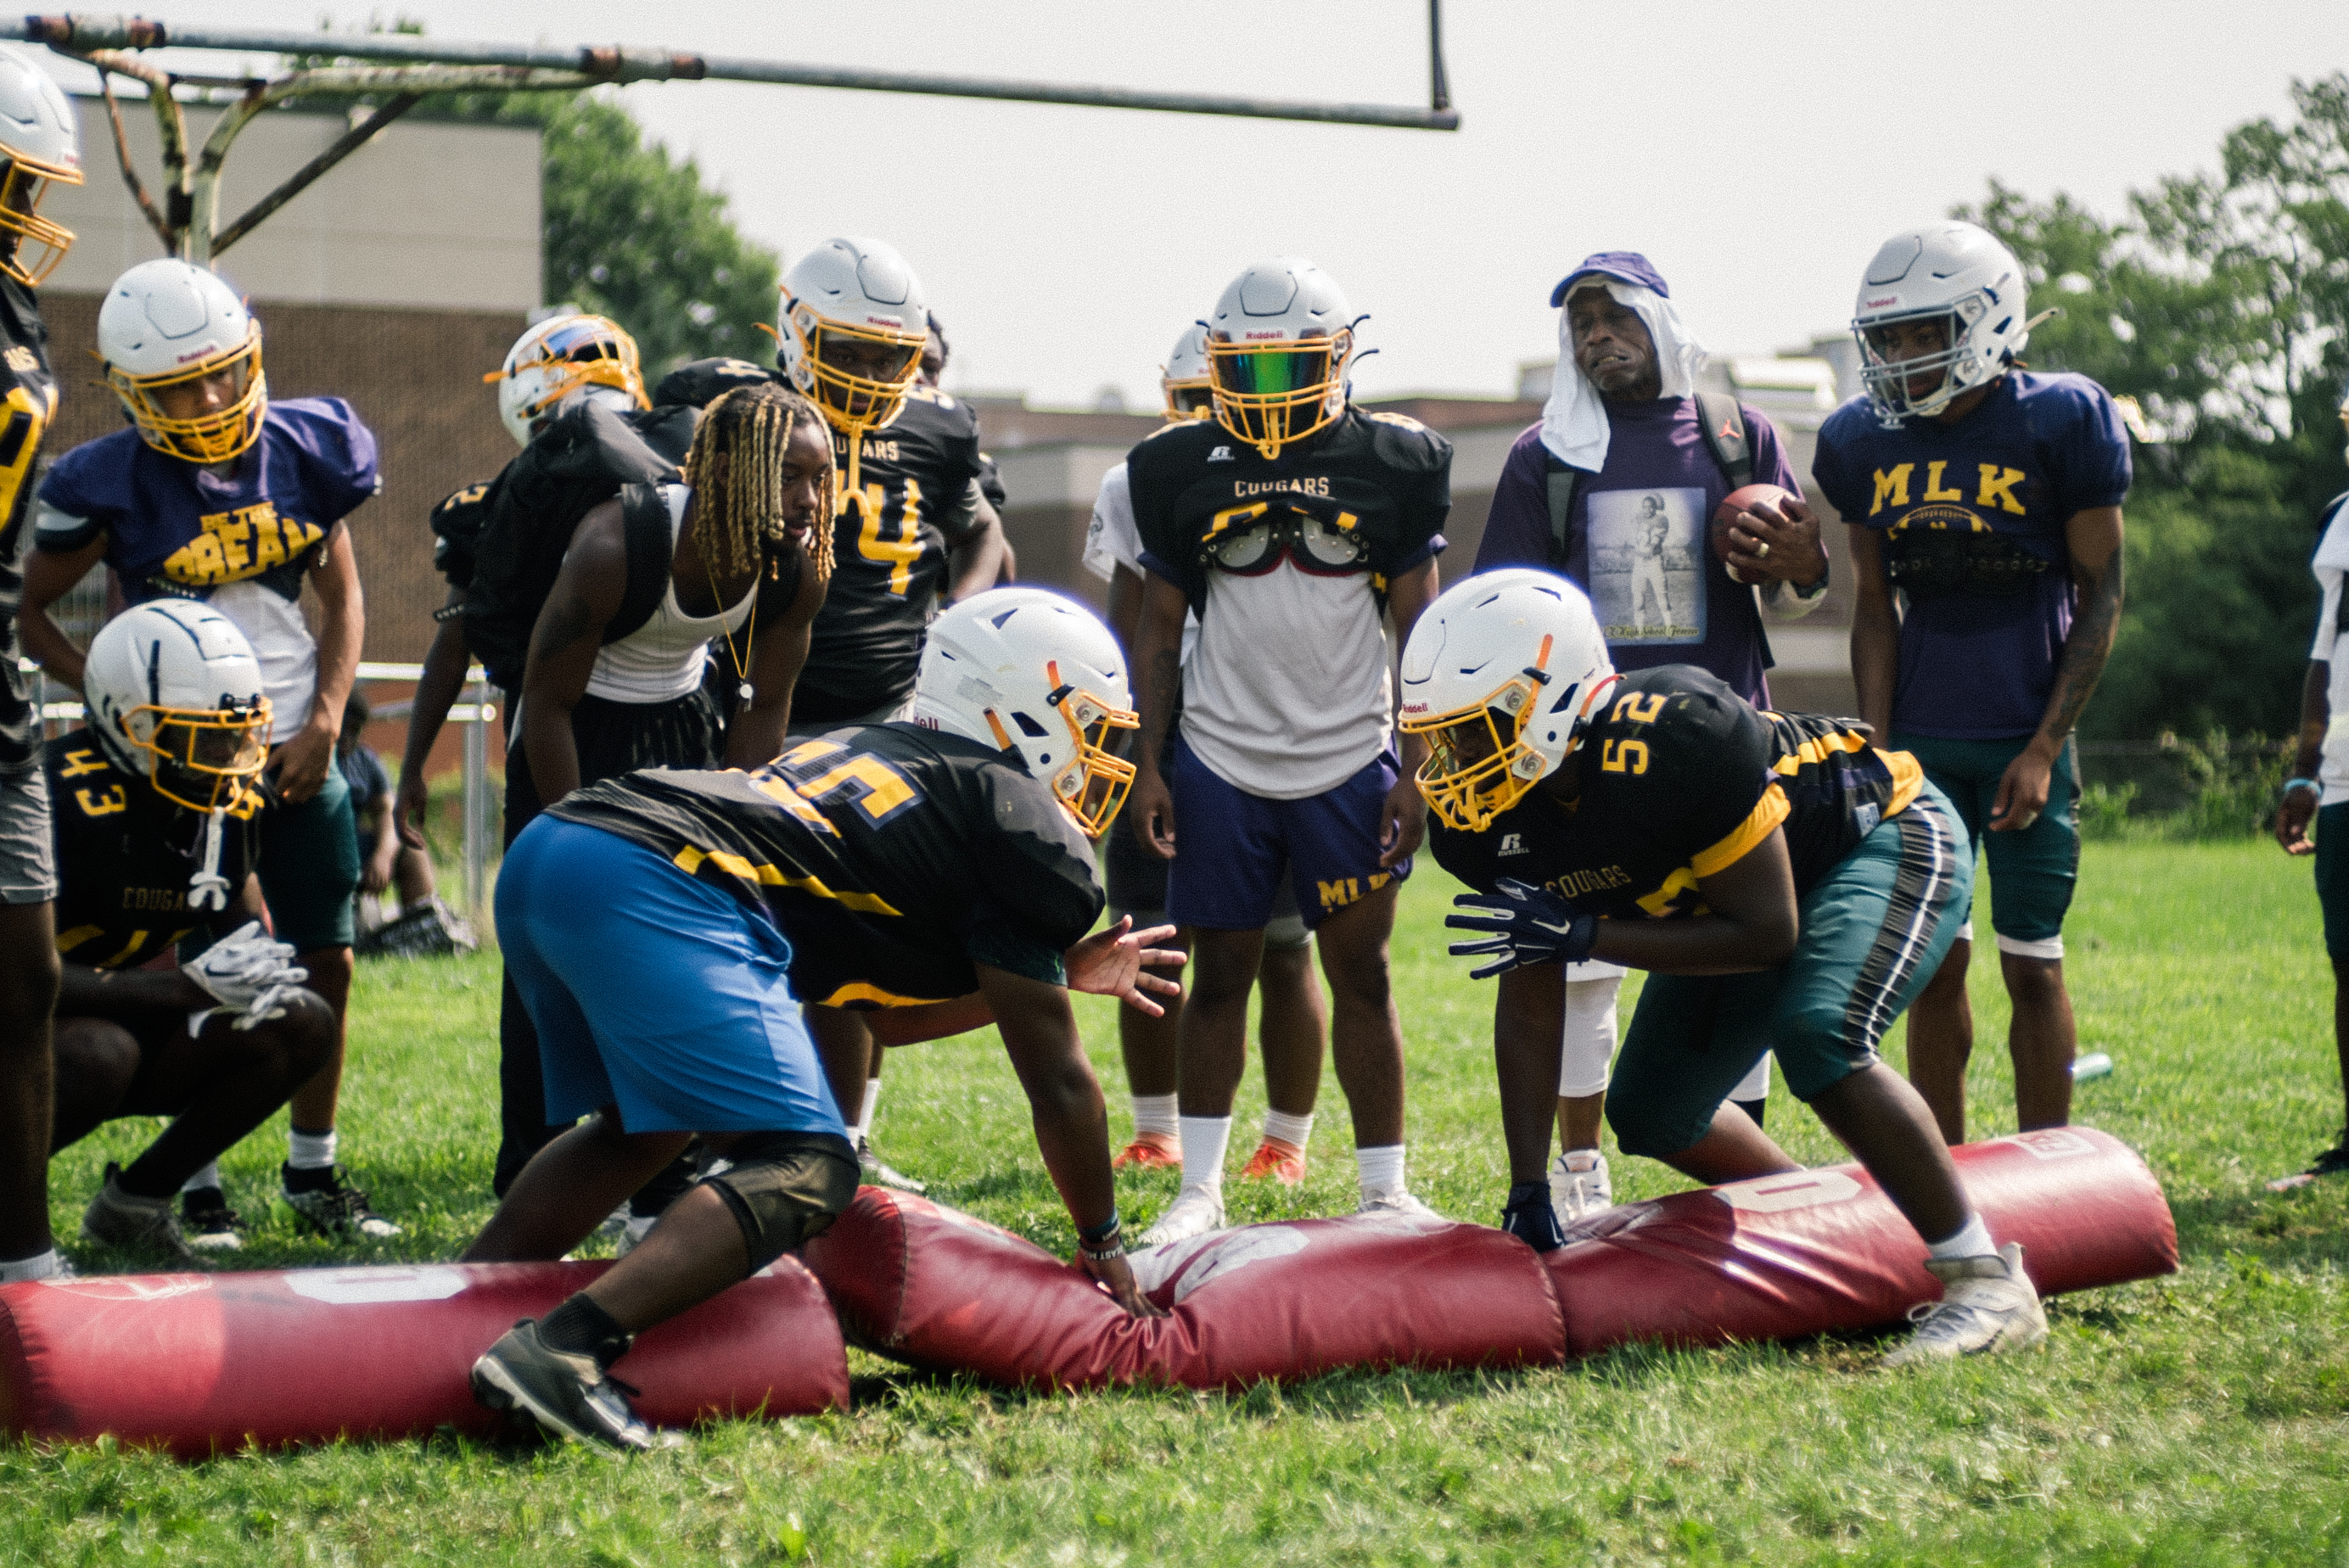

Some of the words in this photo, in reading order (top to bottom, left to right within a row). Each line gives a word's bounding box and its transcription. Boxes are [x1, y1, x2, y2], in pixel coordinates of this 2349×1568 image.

[1246, 330, 1283, 340] Riddell
[1235, 477, 1330, 498] COUGARS
[1869, 460, 2024, 516] MLK
[1601, 691, 1668, 775] 52
[60, 748, 127, 817] 43
[123, 888, 186, 911] COUGA
